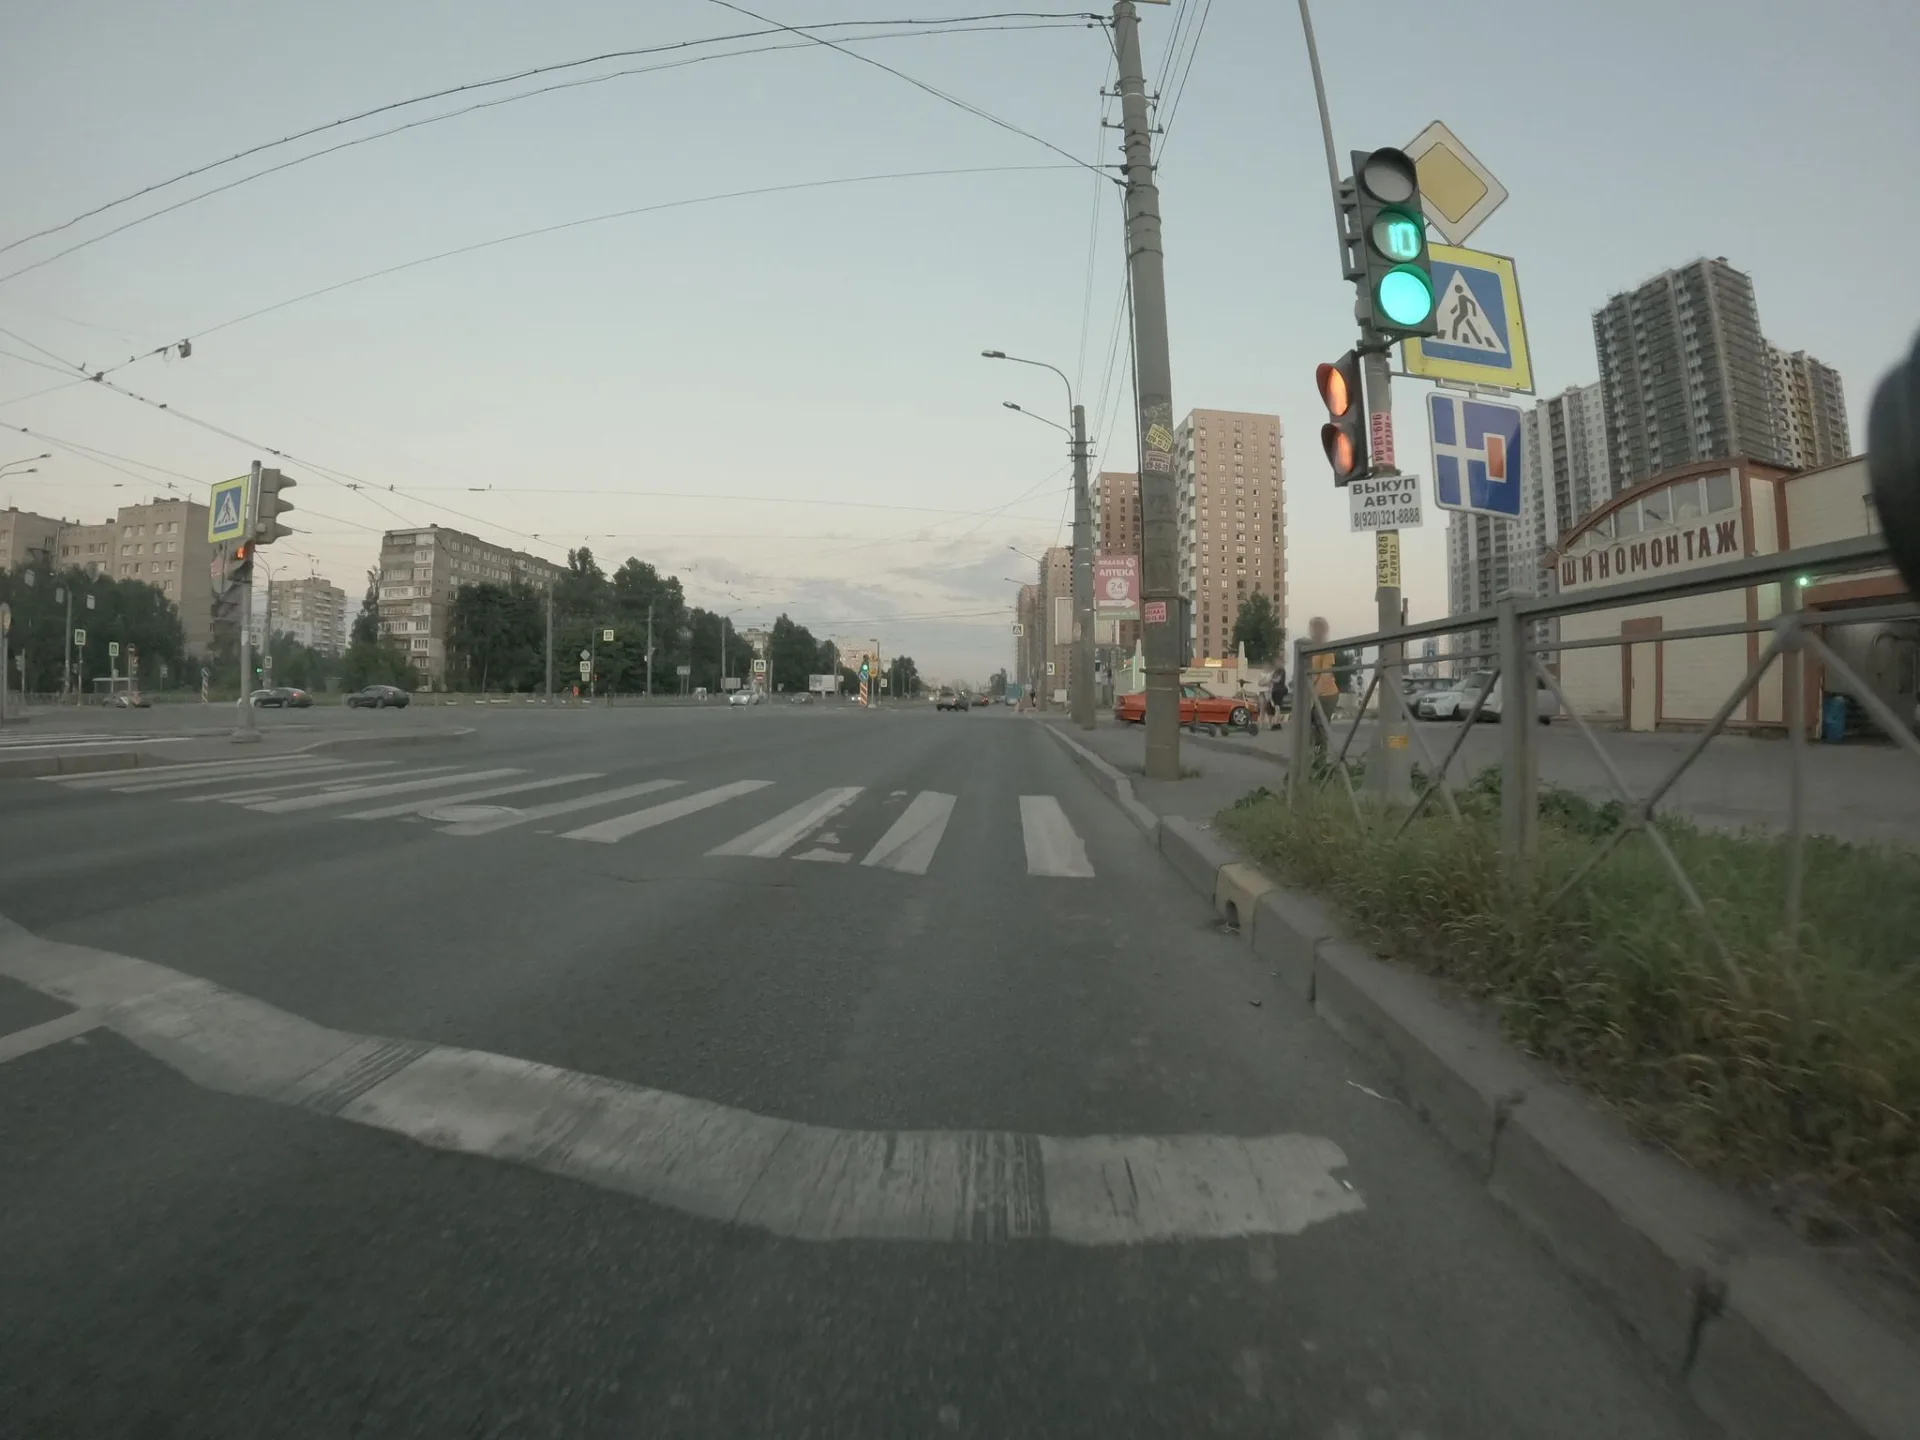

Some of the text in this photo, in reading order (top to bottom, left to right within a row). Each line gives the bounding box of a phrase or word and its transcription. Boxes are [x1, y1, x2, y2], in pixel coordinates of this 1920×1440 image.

[1387, 222, 1418, 257] 10
[1353, 478, 1416, 495] ВЫКУП
[1364, 492, 1412, 508] АВТО
[1354, 507, 1420, 531] 8(920)321-8888
[1562, 520, 1738, 586] ШИНОМОНТАЖ
[1100, 568, 1135, 577] АПТЕКА
